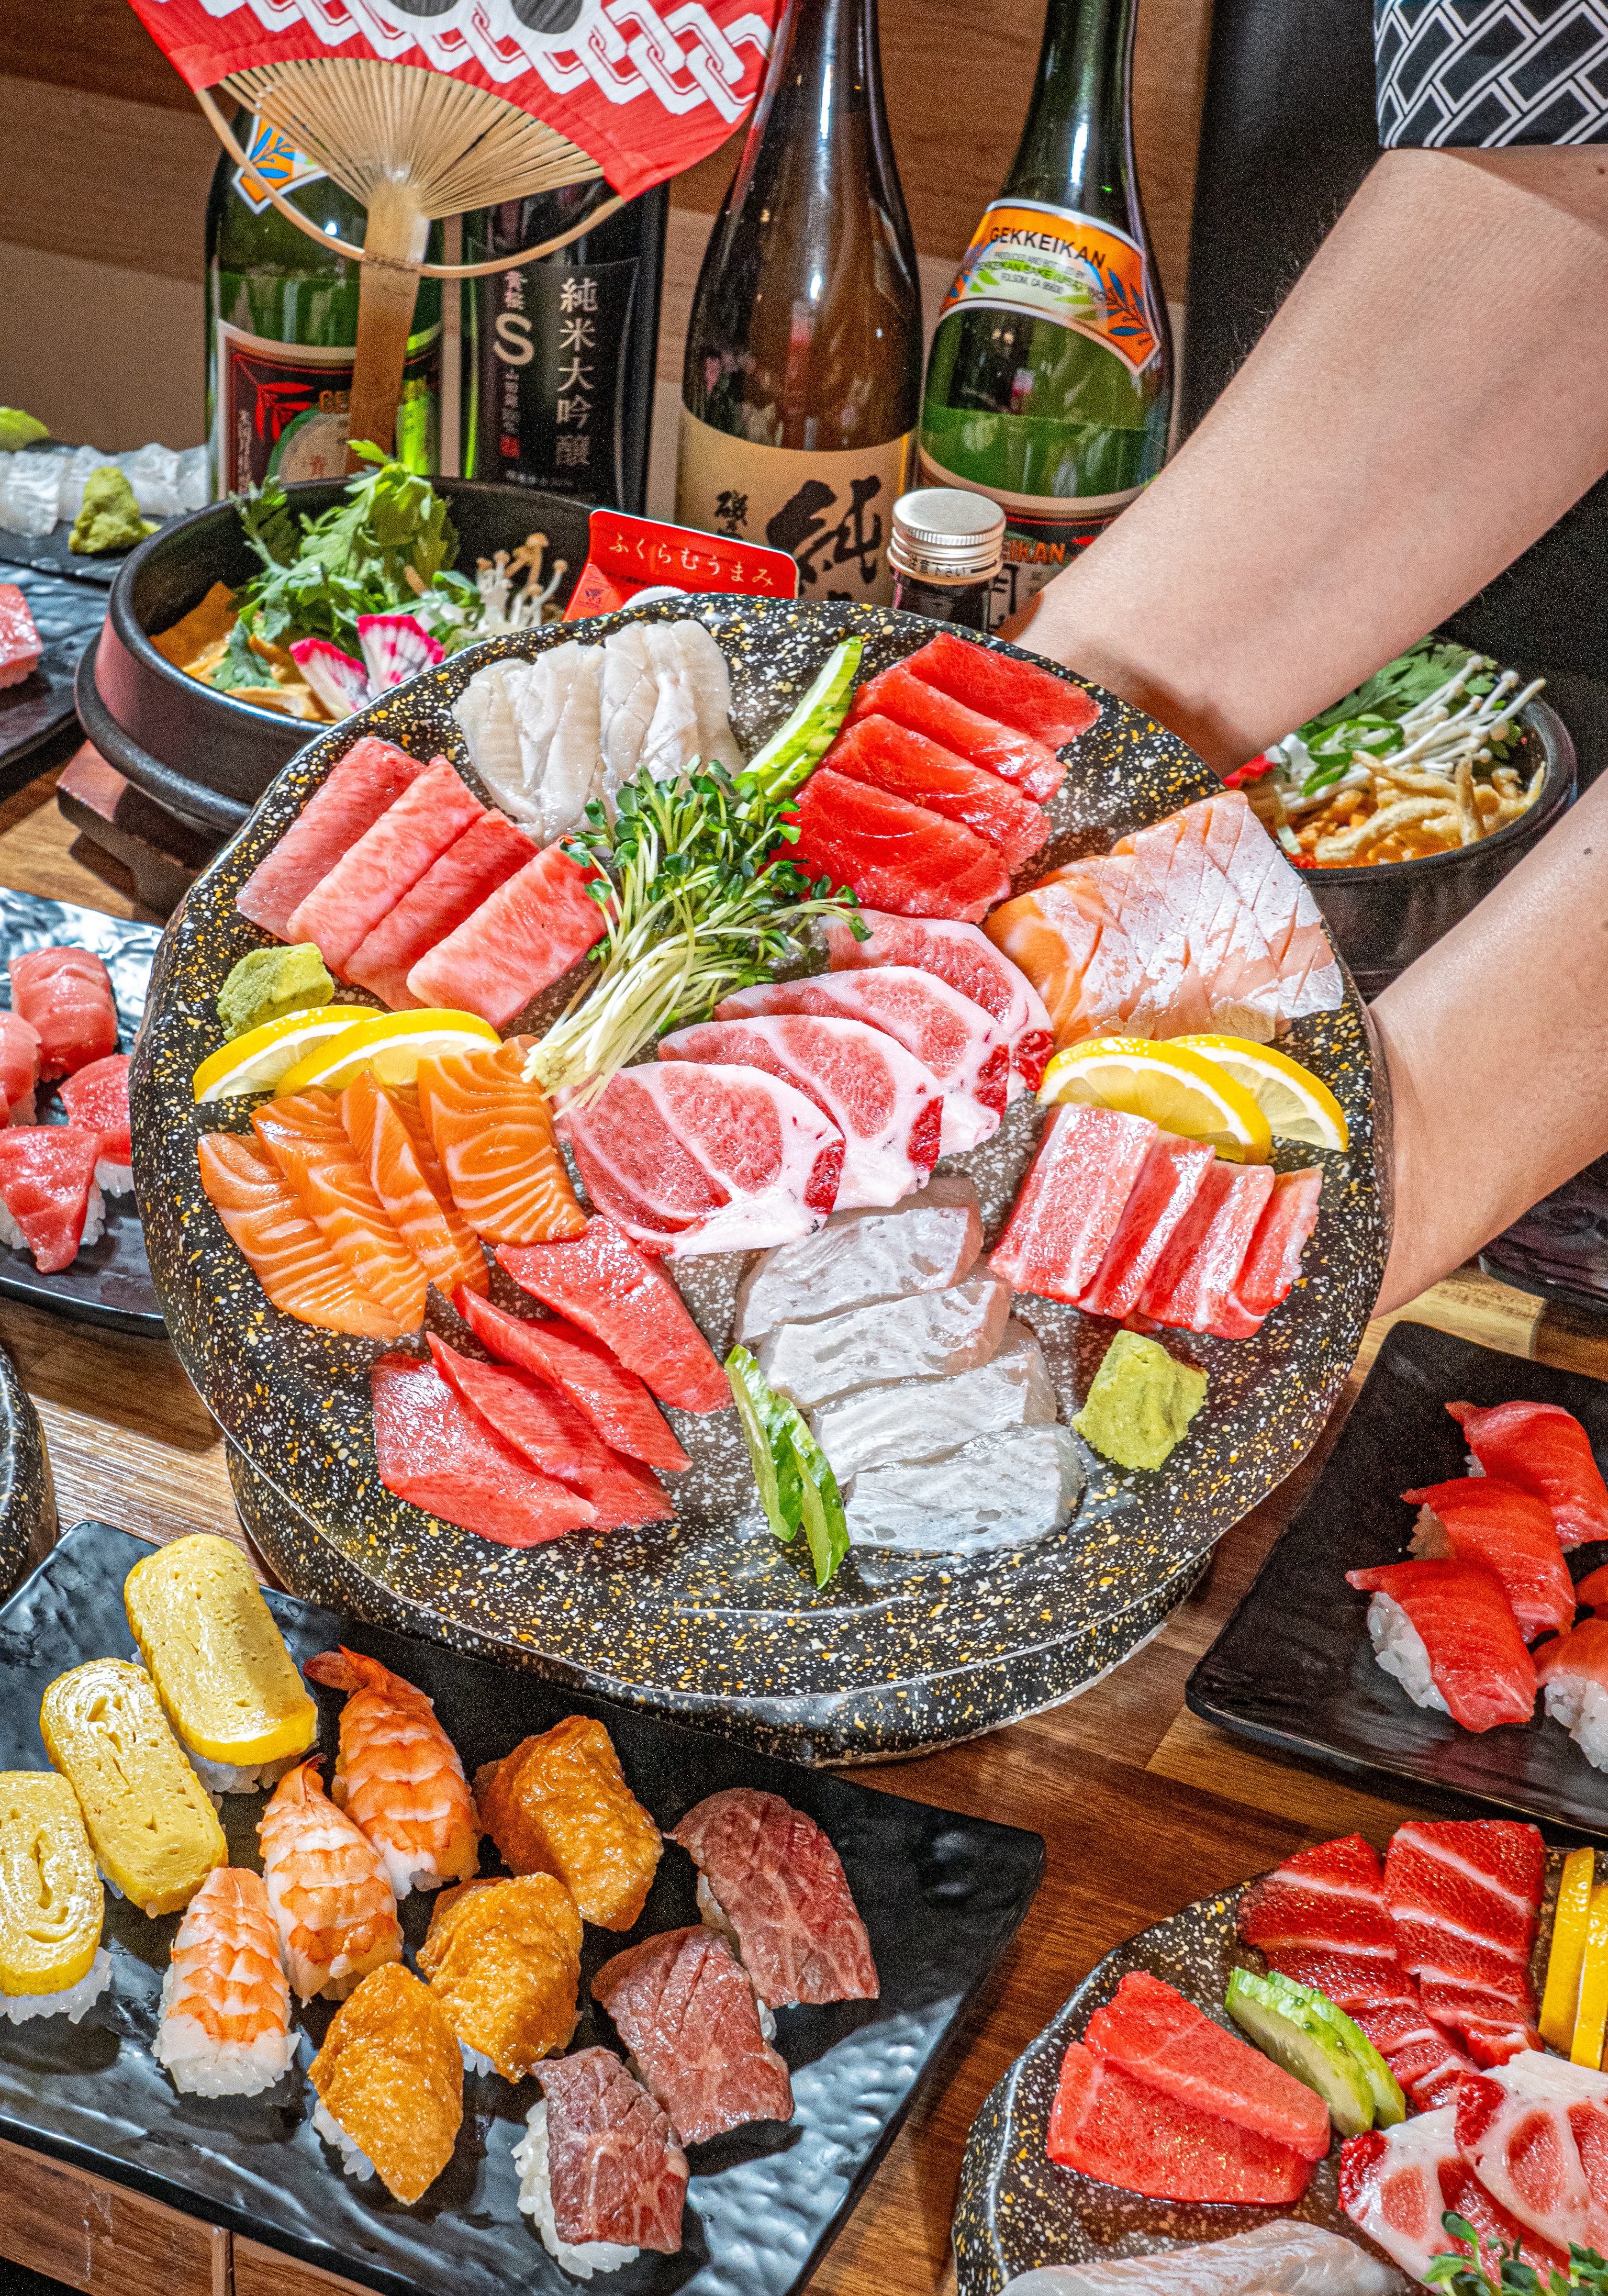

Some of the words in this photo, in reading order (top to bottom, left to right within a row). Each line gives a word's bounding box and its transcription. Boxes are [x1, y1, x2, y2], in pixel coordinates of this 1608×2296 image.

[990, 227, 1106, 269] GEKKEIKAN
[494, 313, 534, 365] S
[609, 533, 774, 587] ふくらむうまみ
